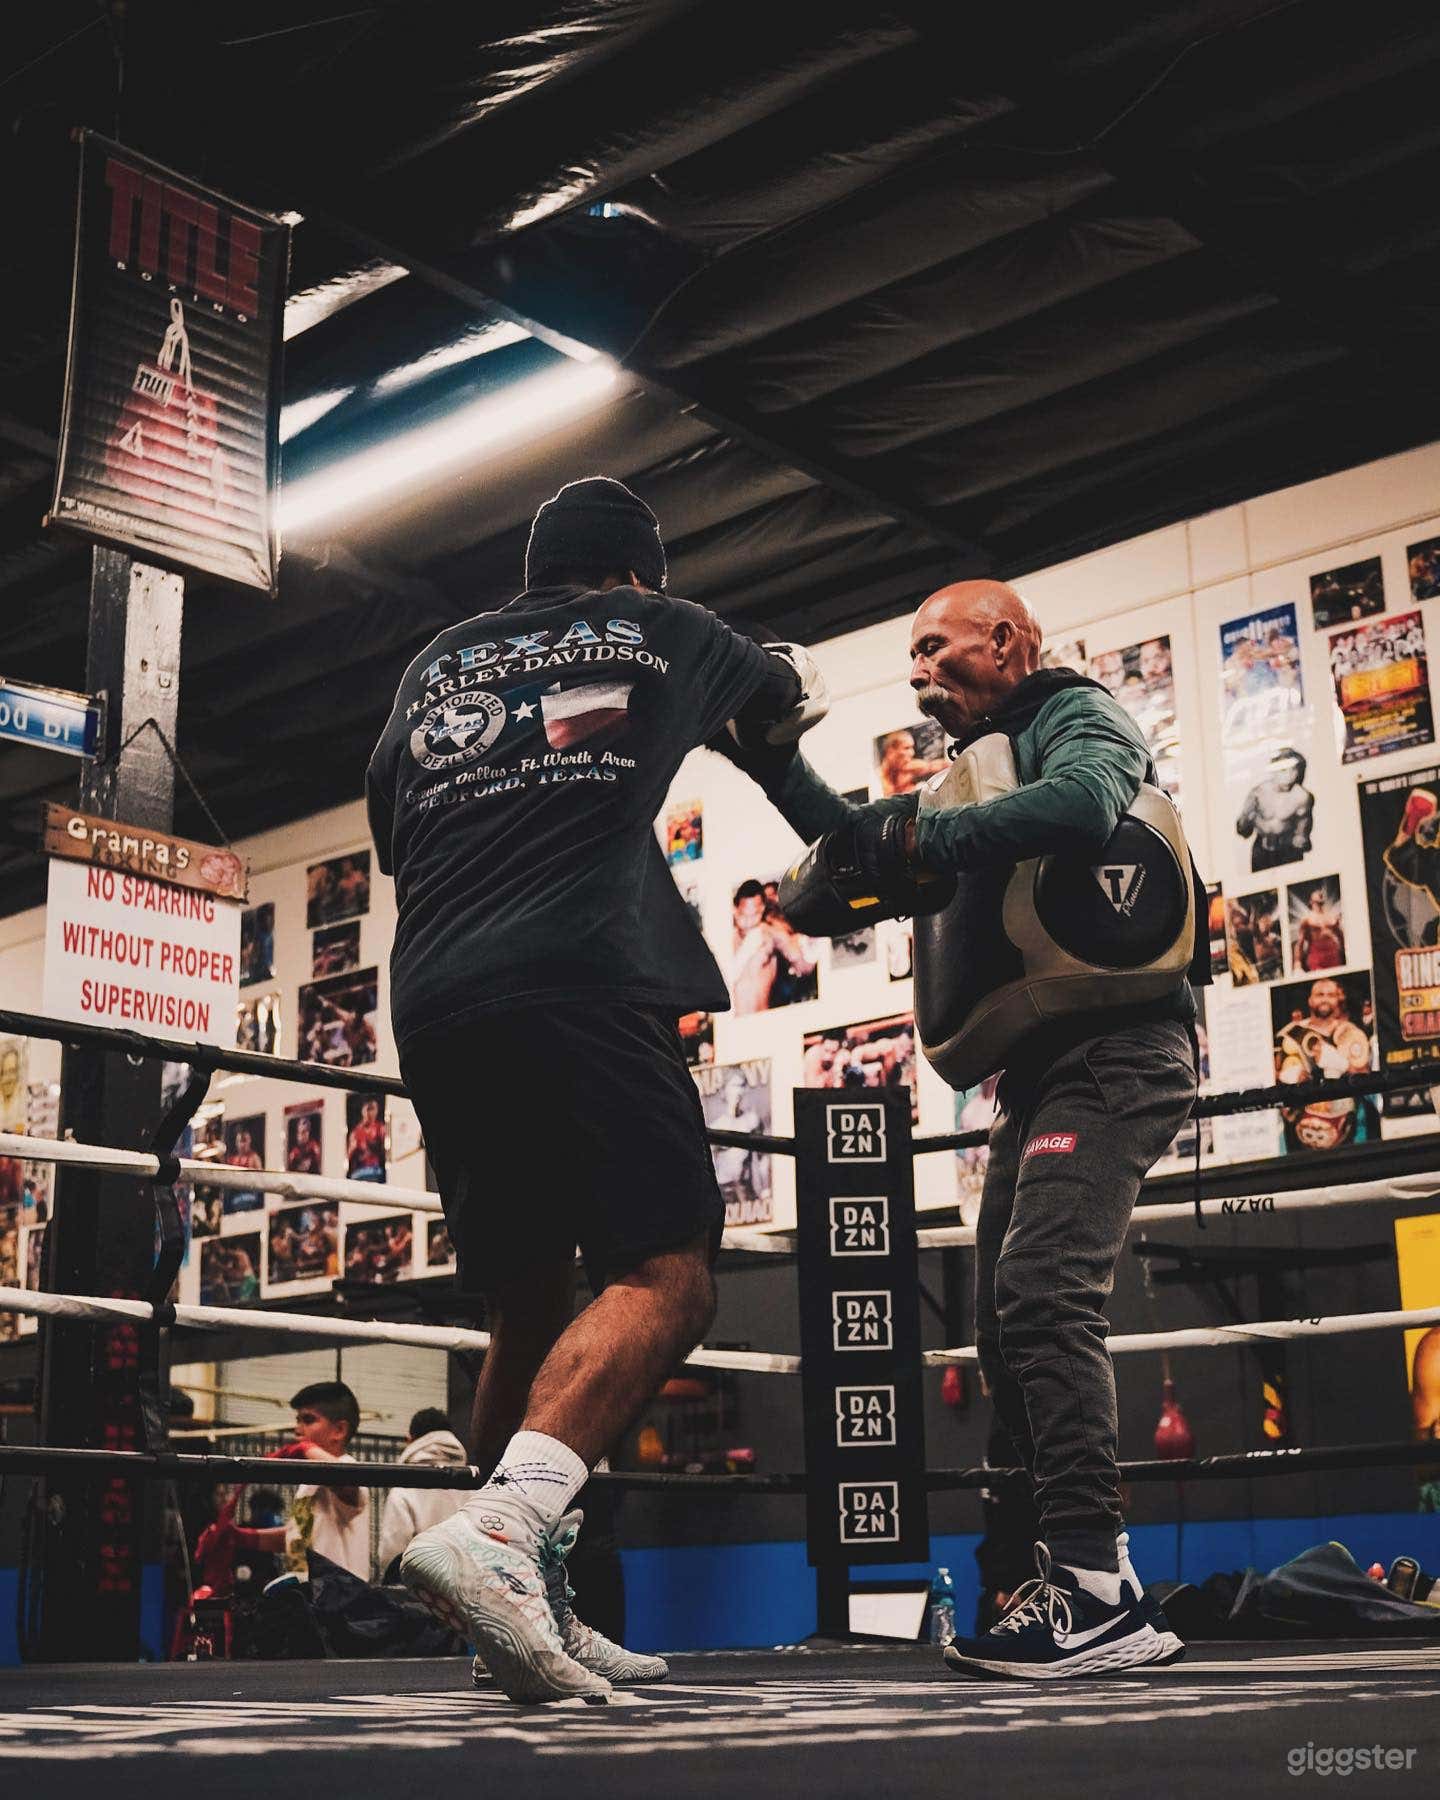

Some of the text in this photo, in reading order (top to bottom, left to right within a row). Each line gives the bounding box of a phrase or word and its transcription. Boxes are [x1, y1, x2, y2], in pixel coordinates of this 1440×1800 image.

[105, 159, 263, 319] TITLE
[116, 260, 248, 323] BOXING
[420, 619, 643, 688] TEXAS
[405, 645, 670, 721] HARLEY-DAVIDSON
[418, 693, 503, 733] AUTHORIZED
[421, 742, 488, 768] DEALER
[455, 765, 507, 785] Dallas
[520, 758, 540, 773] Ft.
[543, 750, 593, 767] Worth
[600, 751, 636, 768] Area
[537, 766, 617, 785] TEXAS
[88, 867, 216, 924] NO SPARRING
[63, 920, 234, 984] WITHOUT PROPER
[80, 979, 210, 1033] SUPERVISION
[841, 1113, 873, 1132] DA
[842, 1135, 873, 1153] ZN
[1025, 1136, 1073, 1156] AVAGE
[844, 1206, 875, 1225] DA
[1221, 1197, 1276, 1215] DAZN
[845, 1228, 876, 1246] ZN
[847, 1300, 878, 1319] DA
[848, 1323, 879, 1341] ZN
[850, 1396, 882, 1414] DA
[851, 1418, 882, 1437] ZN
[853, 1492, 885, 1511] DA
[854, 1514, 886, 1533] ZN
